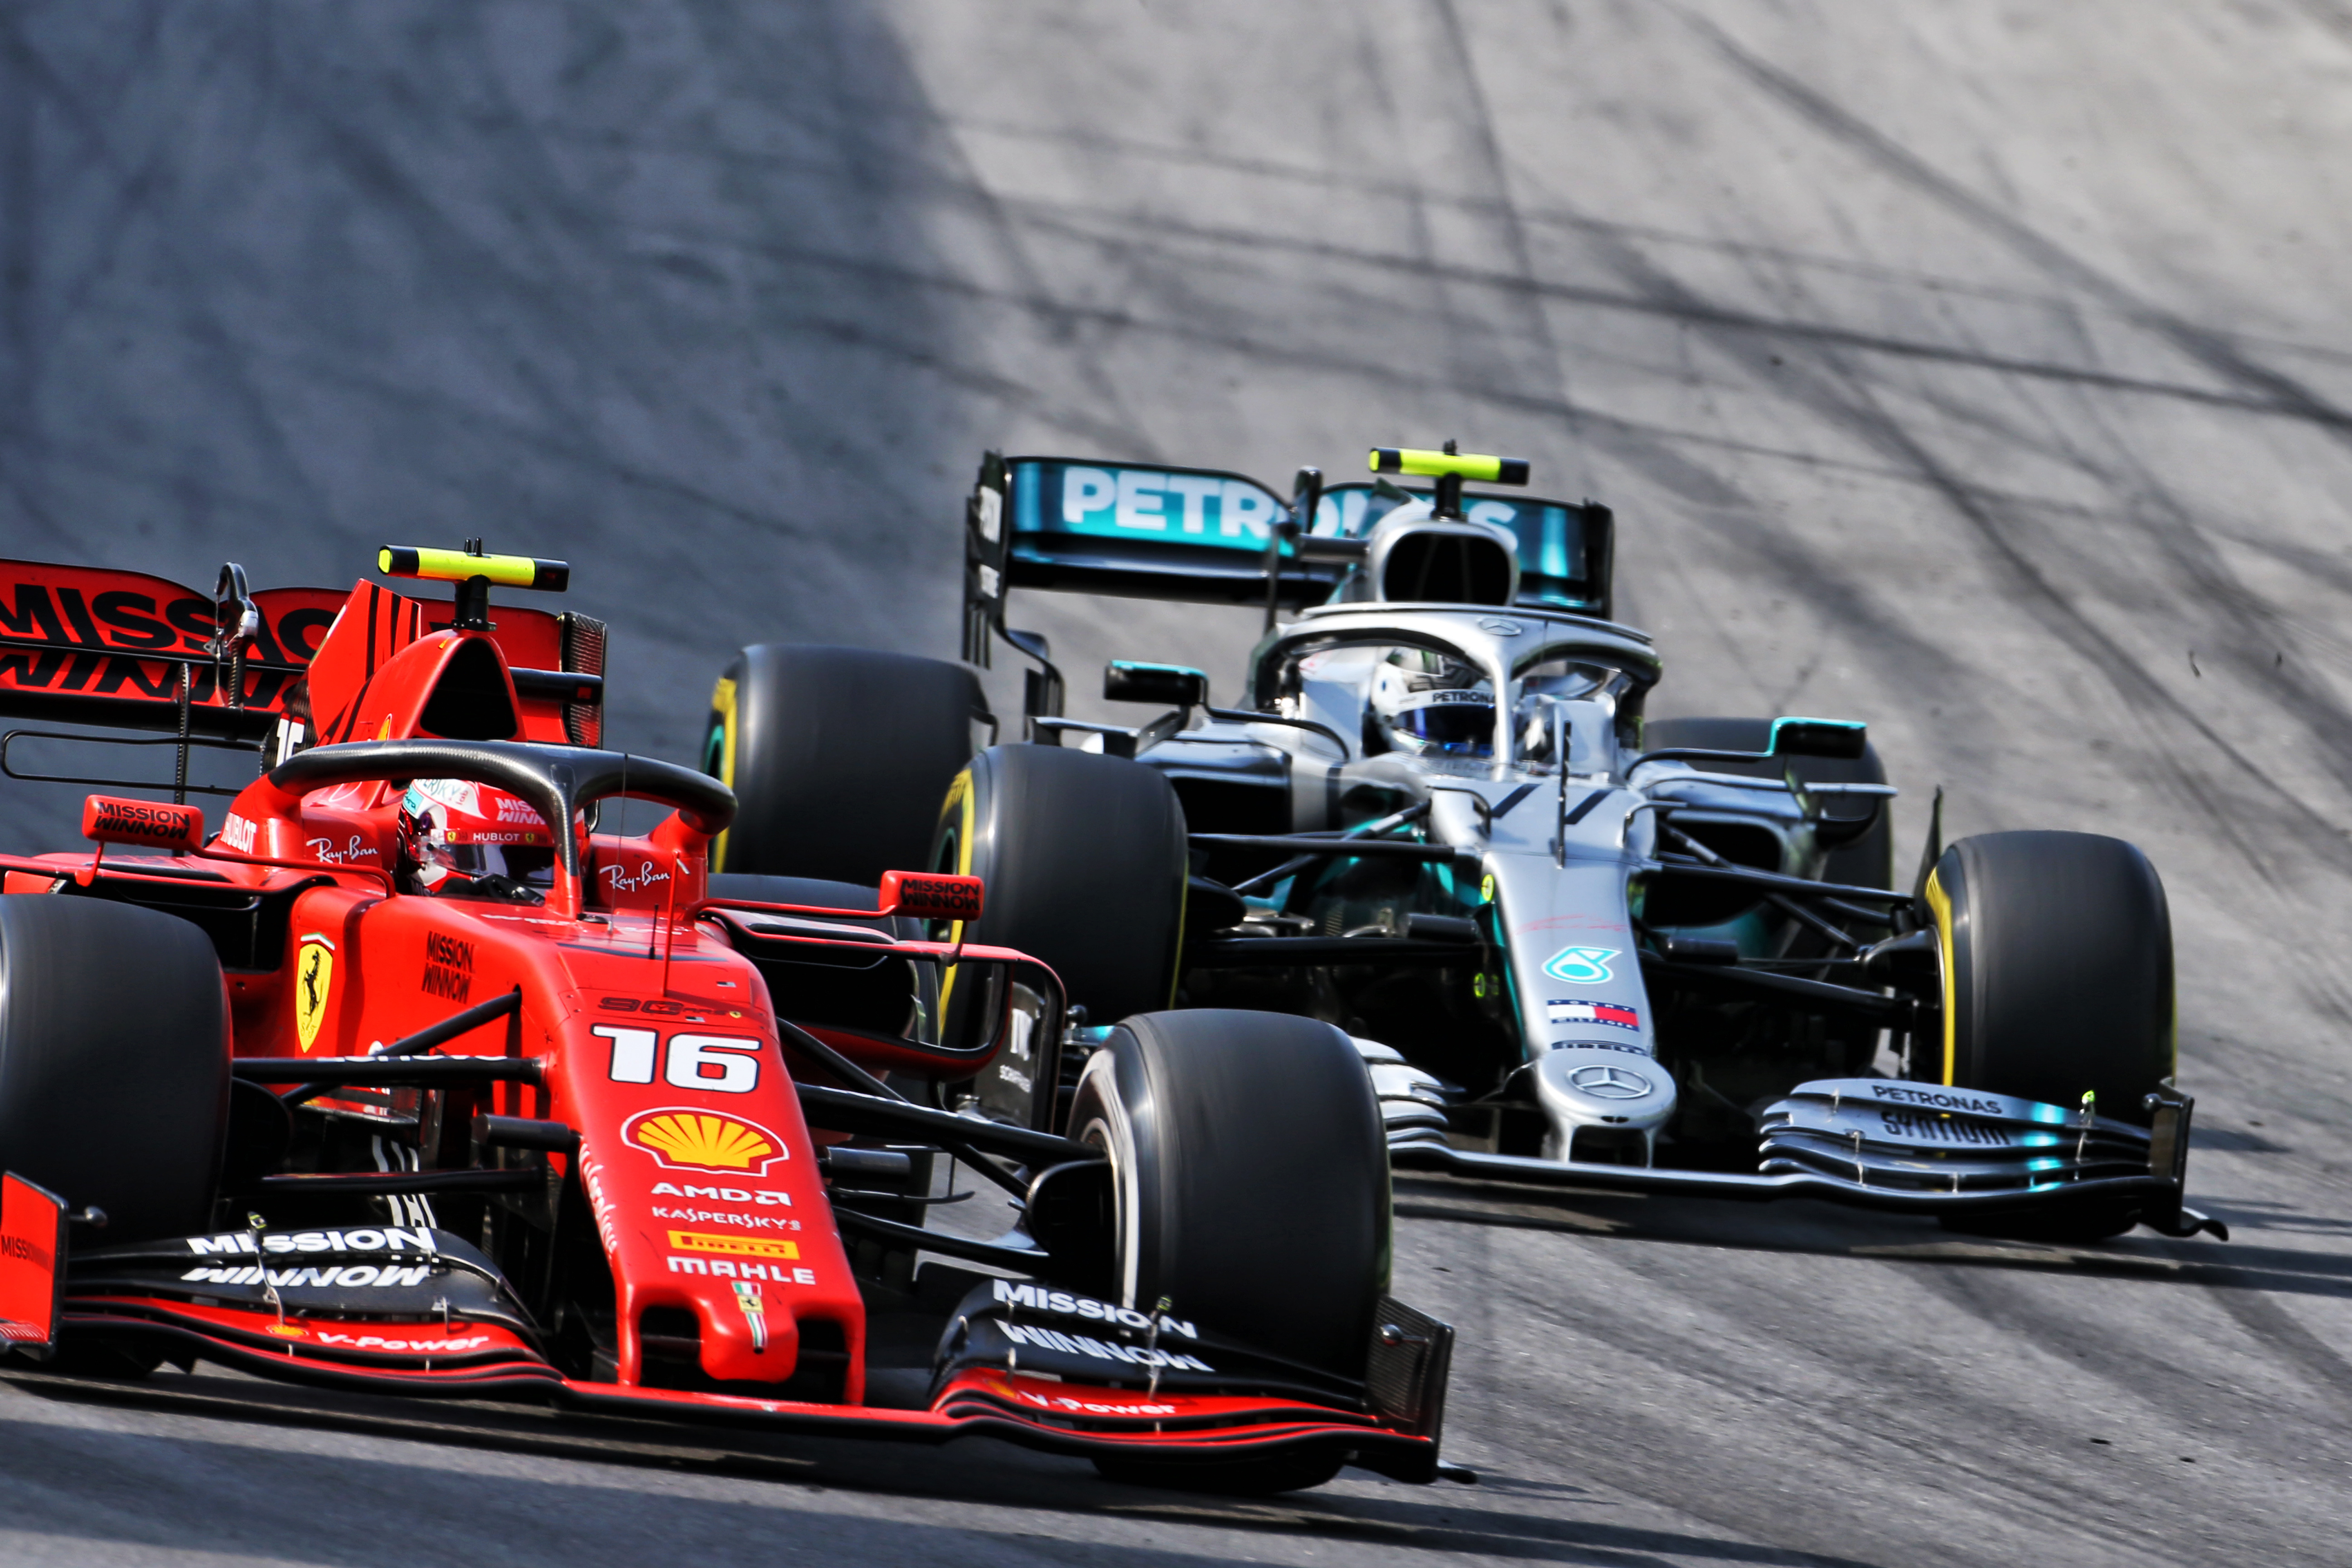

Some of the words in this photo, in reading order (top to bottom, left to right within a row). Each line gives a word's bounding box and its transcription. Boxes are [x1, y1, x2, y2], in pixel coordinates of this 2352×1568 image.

[98, 802, 190, 826] MISSION
[495, 798, 537, 812] MIS
[93, 815, 189, 839] WINNOW
[473, 832, 520, 841] HUBLOT
[306, 835, 377, 864] Ray-Ban
[599, 861, 670, 892] Ray-Ban
[901, 878, 980, 896] MISSION
[900, 892, 980, 910] WINNOW
[426, 930, 474, 973] MISSION
[421, 962, 471, 1004] WINNOW
[1554, 1000, 1630, 1011] TOMMY
[591, 1023, 763, 1093] 16
[1872, 1085, 2003, 1114] PETRONAS
[651, 1182, 753, 1202] AMD
[652, 1206, 787, 1230] KASPERSKY
[186, 1226, 436, 1255] MISSION
[181, 1265, 431, 1287] WINNOW
[666, 1255, 816, 1285] MAHLE
[993, 1278, 1197, 1339] MISSION
[317, 1332, 489, 1351] V-Power
[993, 1318, 1216, 1372] WINNOW
[1019, 1390, 1176, 1415] V-Power
